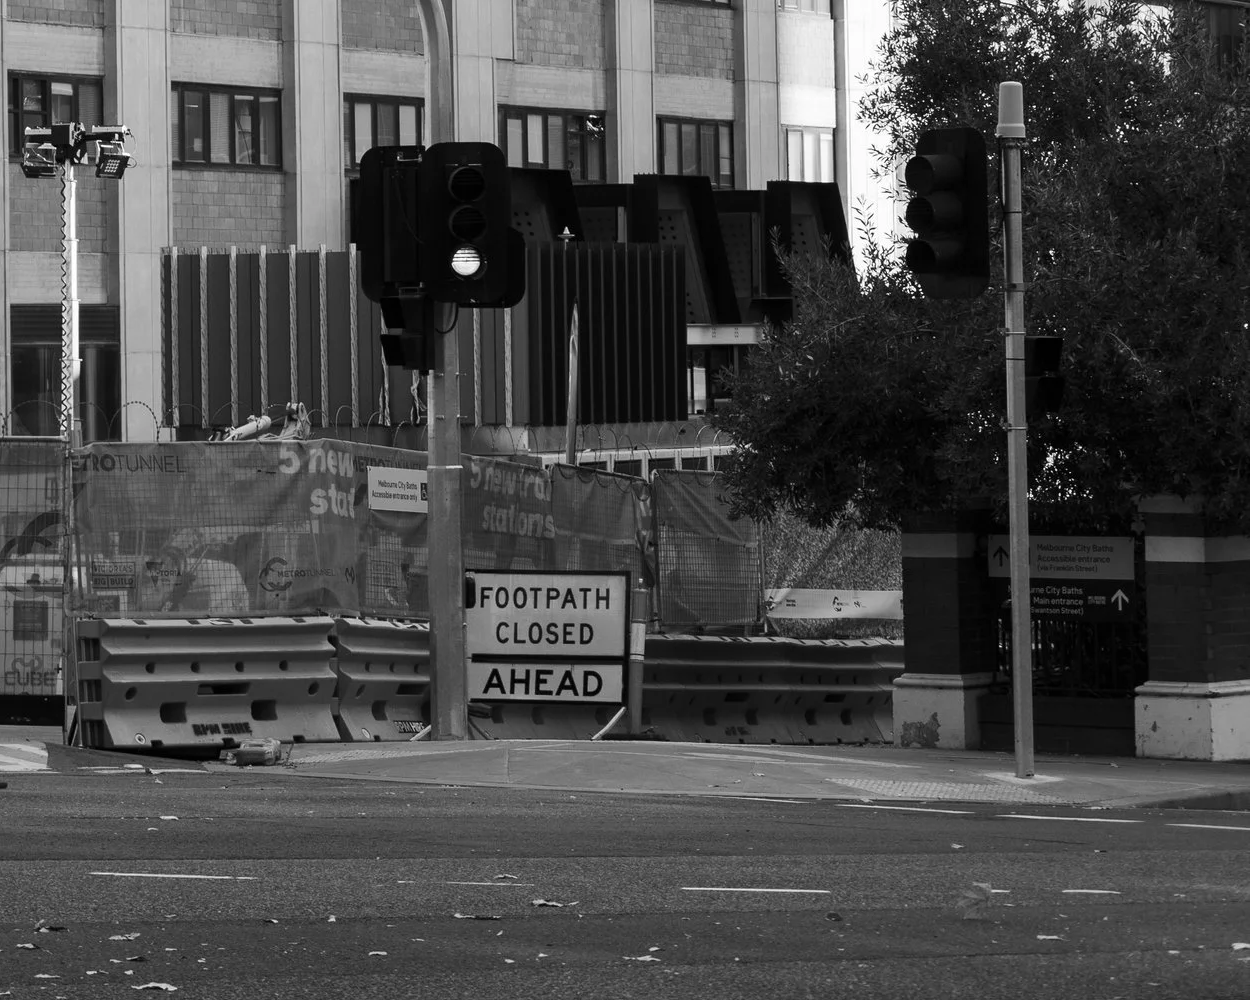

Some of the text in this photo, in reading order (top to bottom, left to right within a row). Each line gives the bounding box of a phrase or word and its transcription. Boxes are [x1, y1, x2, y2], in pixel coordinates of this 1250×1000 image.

[71, 453, 187, 473] ETROTUNNEL
[279, 446, 354, 478] 5 new
[378, 480, 398, 489] Melbourne
[470, 462, 482, 489] 5
[484, 466, 516, 495] new
[372, 490, 392, 499] Accessible
[1037, 544, 1114, 554] Melbourne City Baths
[1038, 555, 1076, 563] Accessible
[479, 587, 610, 610] FOOTPATH
[1046, 586, 1060, 596] City
[1061, 586, 1083, 594] Baths
[1033, 597, 1050, 605] Main
[1051, 598, 1084, 606] entrance
[496, 621, 594, 644] CLOSED
[482, 668, 603, 697] AHEAD
